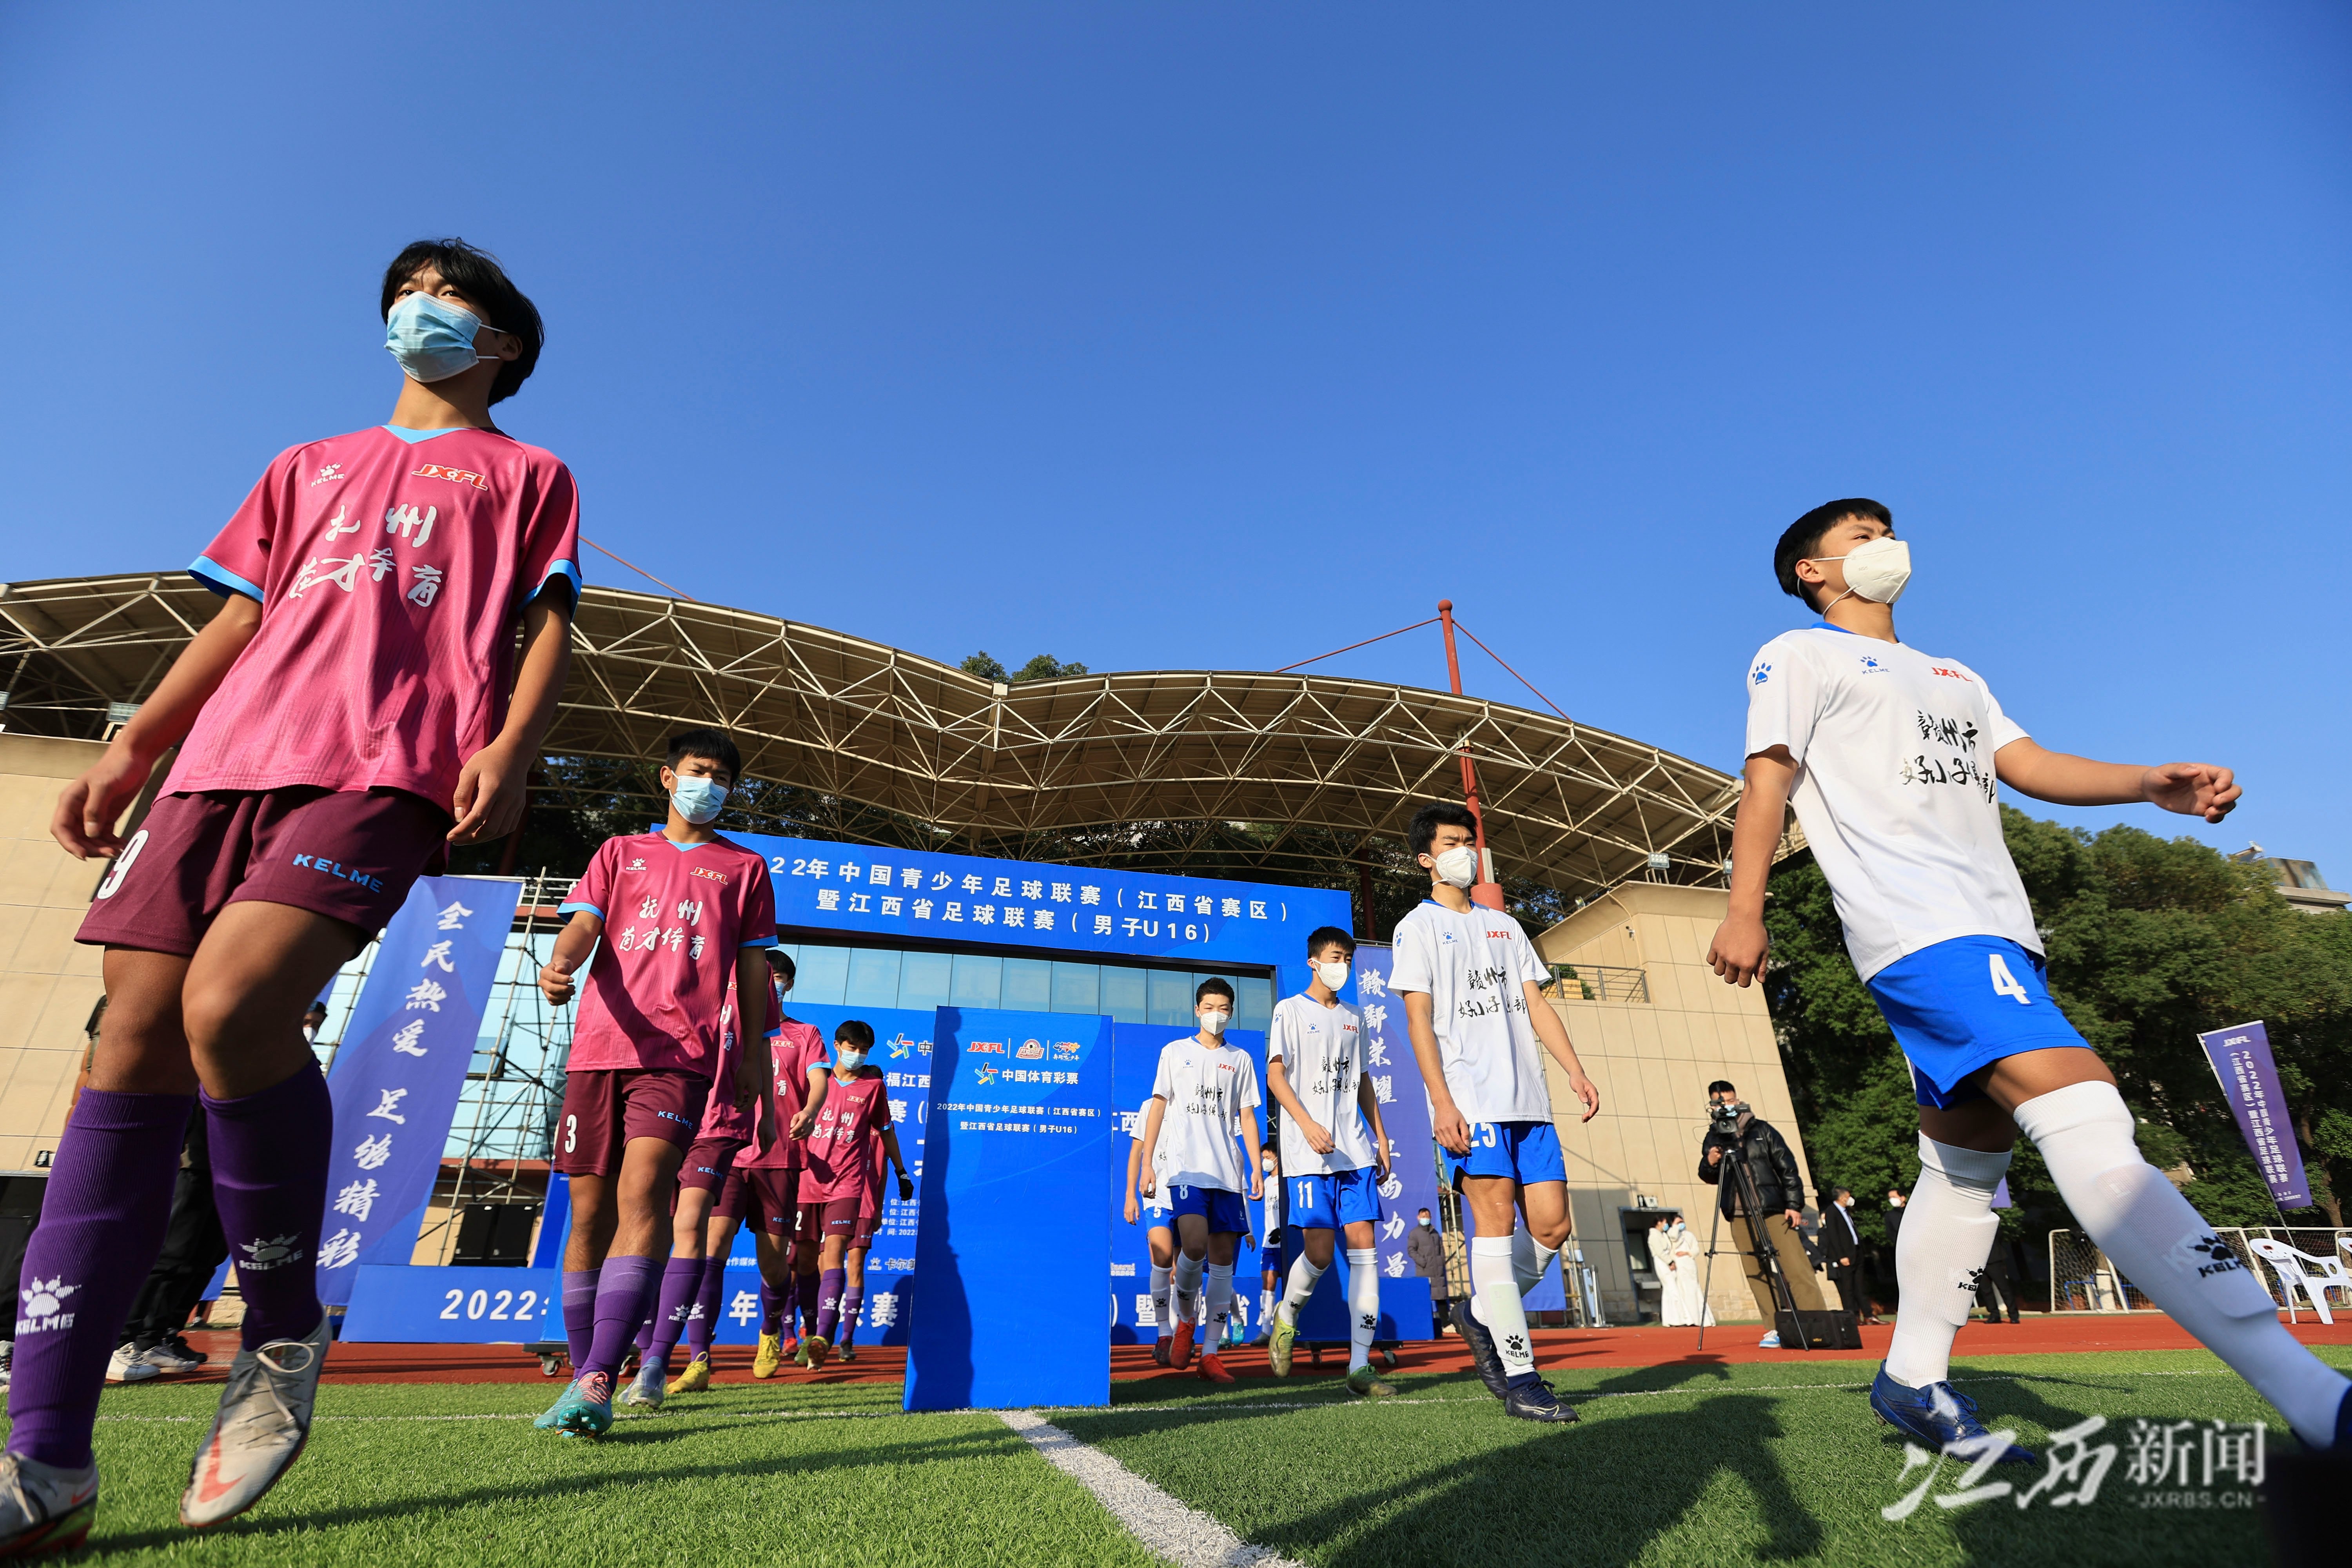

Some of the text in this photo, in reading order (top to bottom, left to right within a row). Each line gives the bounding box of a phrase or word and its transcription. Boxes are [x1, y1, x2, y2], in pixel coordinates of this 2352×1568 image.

[311, 473, 345, 488] KELME
[97, 829, 149, 900] 9
[293, 853, 383, 894] KELME
[1989, 954, 2031, 1004] 4
[316, 901, 473, 1271] 全民热爱 足够精彩
[883, 1072, 931, 1088] 福江西
[1002, 1069, 1078, 1085] 中国体育彩票
[657, 1111, 693, 1130] KELME
[564, 1114, 577, 1154] 3
[697, 1166, 724, 1180] KELME
[1180, 1185, 1188, 1200] 8
[1298, 1181, 1313, 1209] 11
[795, 1210, 802, 1231] 2
[889, 1208, 920, 1216] 位:江西
[1153, 1207, 1161, 1218] 5
[881, 1218, 919, 1226] 单位:江西
[239, 1249, 303, 1271] KELME
[2198, 1259, 2247, 1278] KELM
[1958, 1281, 1979, 1292] KEL
[440, 1289, 549, 1321] 2022
[15, 1313, 75, 1336] KELME
[1506, 1350, 1529, 1359] KELME
